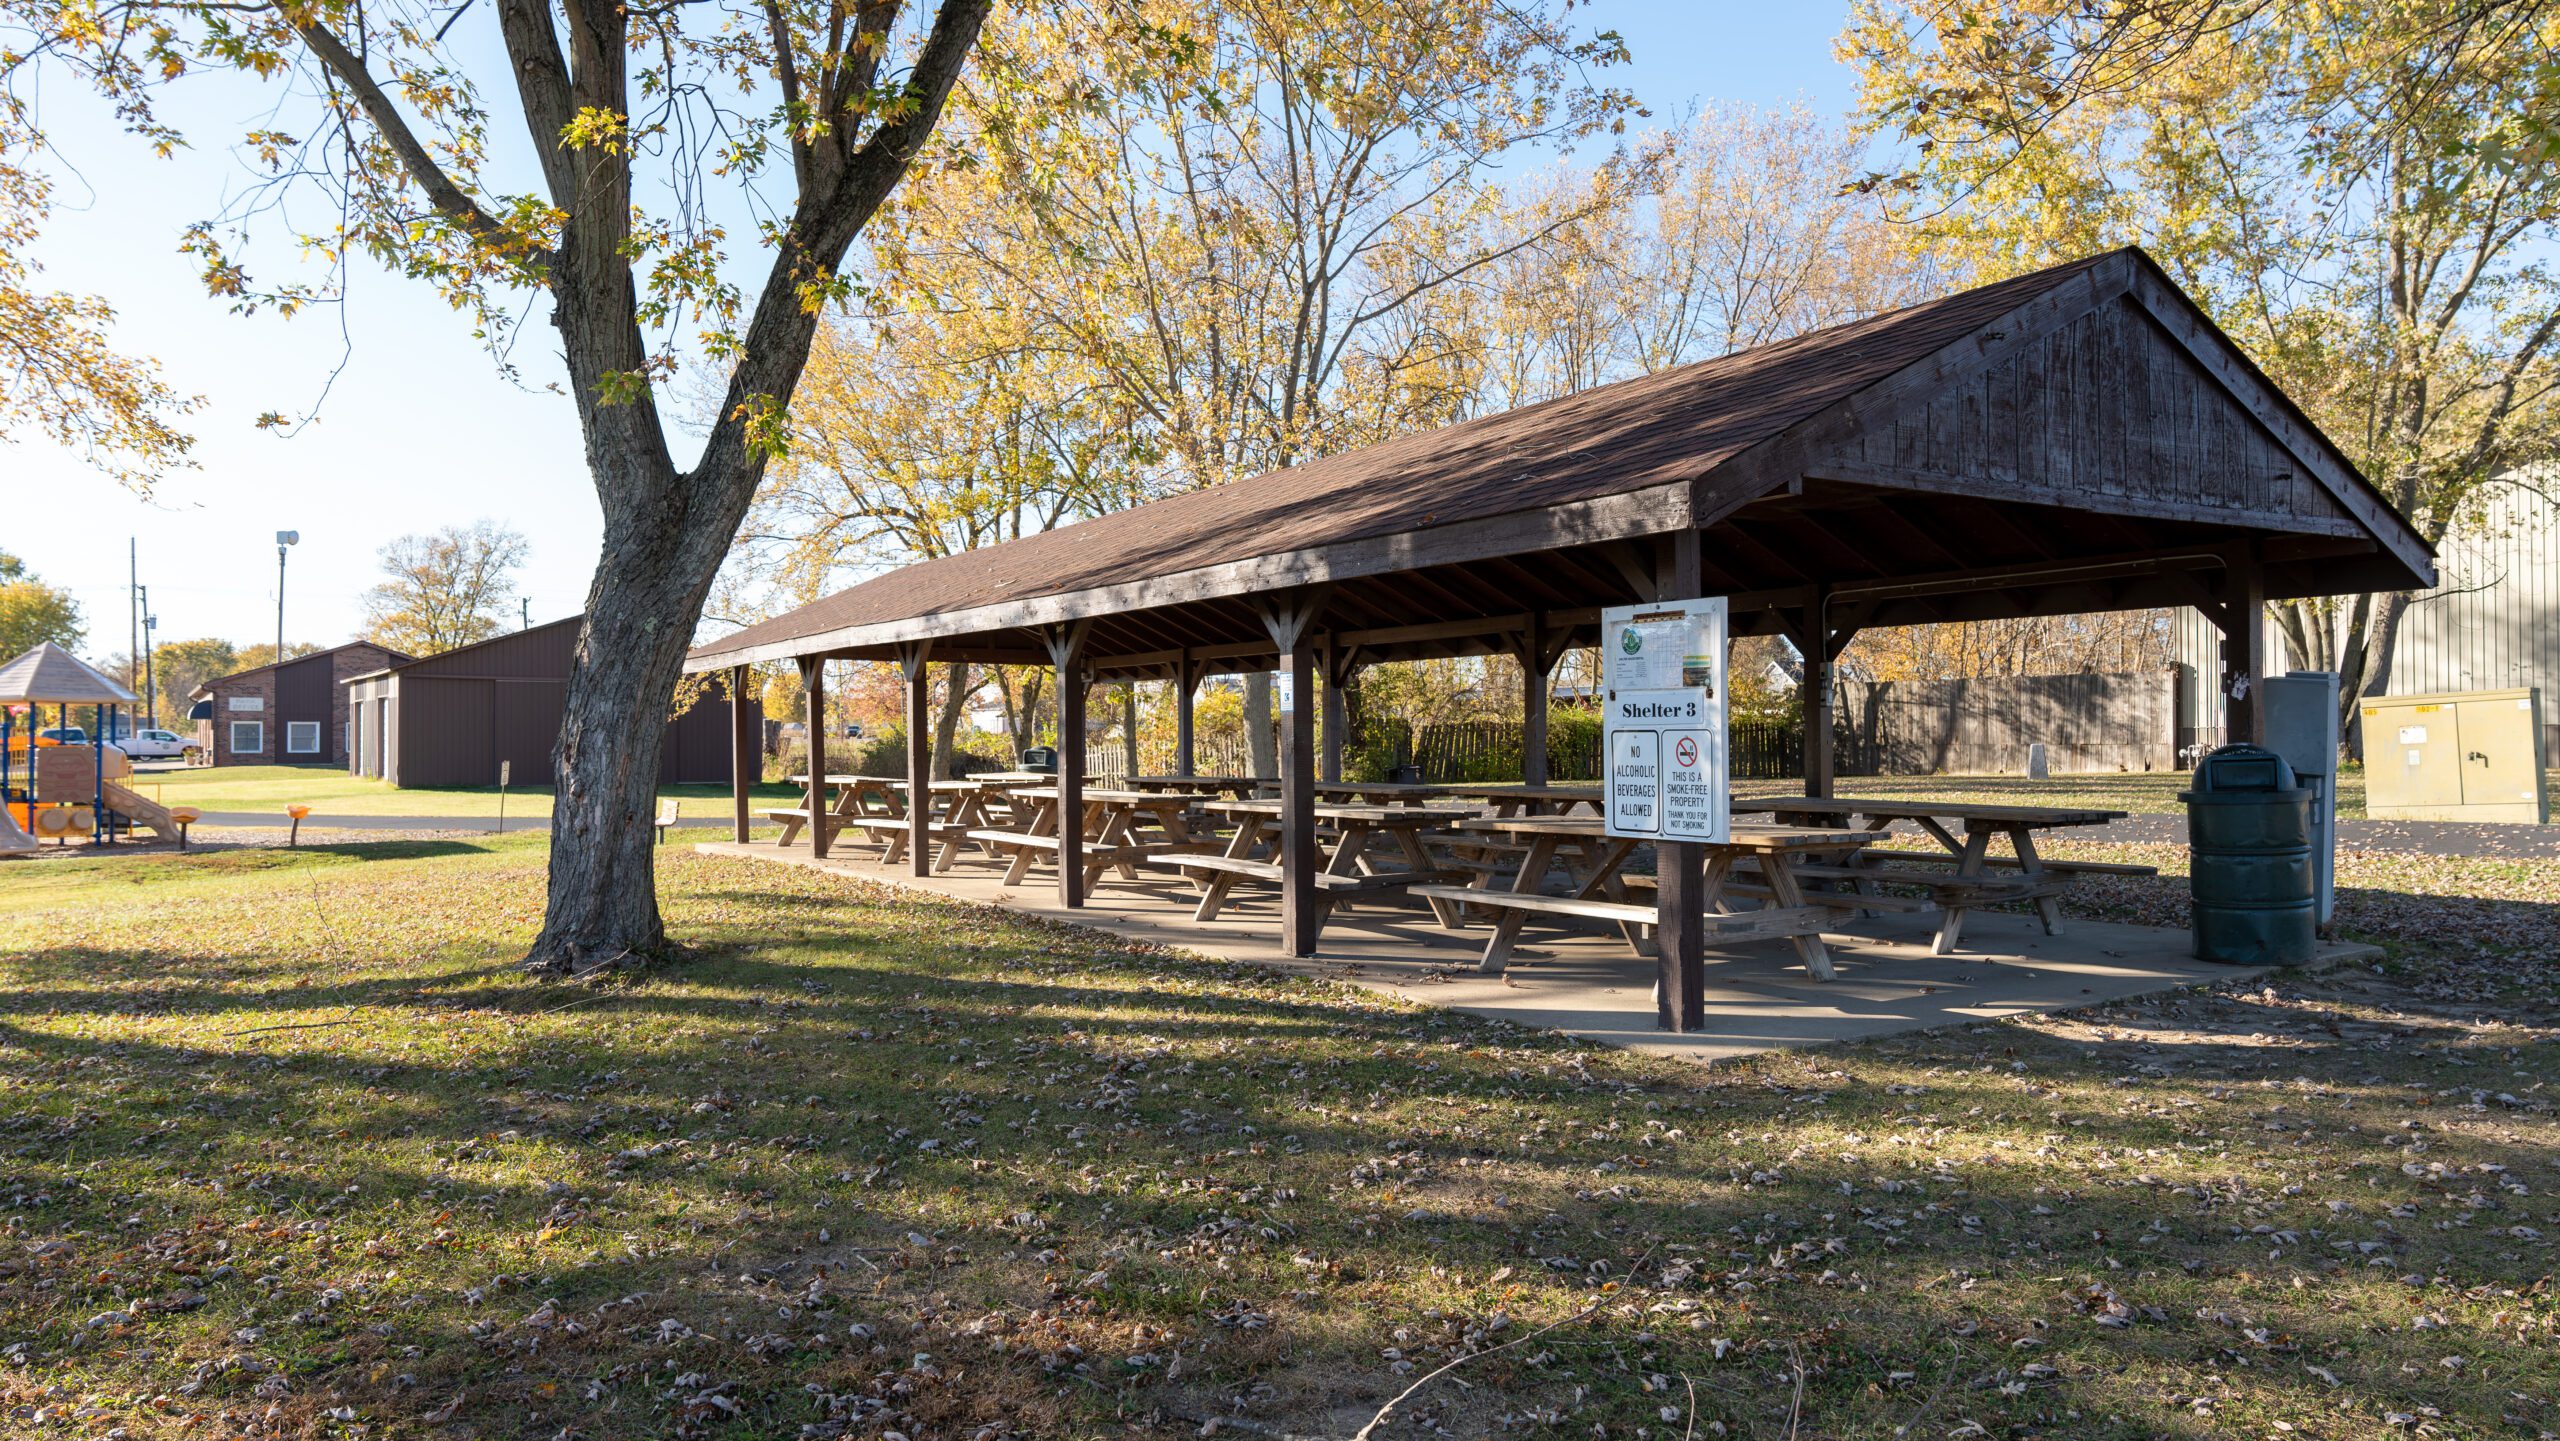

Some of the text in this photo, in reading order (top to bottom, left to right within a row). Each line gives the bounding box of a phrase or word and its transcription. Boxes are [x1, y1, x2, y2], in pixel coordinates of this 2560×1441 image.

[1622, 703, 1696, 718] Shelter 3
[1631, 746, 1640, 758] NO
[1616, 765, 1655, 778] ALCOHOLIC
[1672, 772, 1702, 782] THIS IS A
[1617, 785, 1655, 797] BEVERAGES
[1667, 784, 1708, 794] SMOKE-FREE
[1671, 796, 1704, 807] PROPERTY
[1621, 804, 1652, 816] ALLOWED
[1668, 811, 1707, 821] THANK YOU FOR
[1671, 820, 1704, 830] NOT SMOKING
